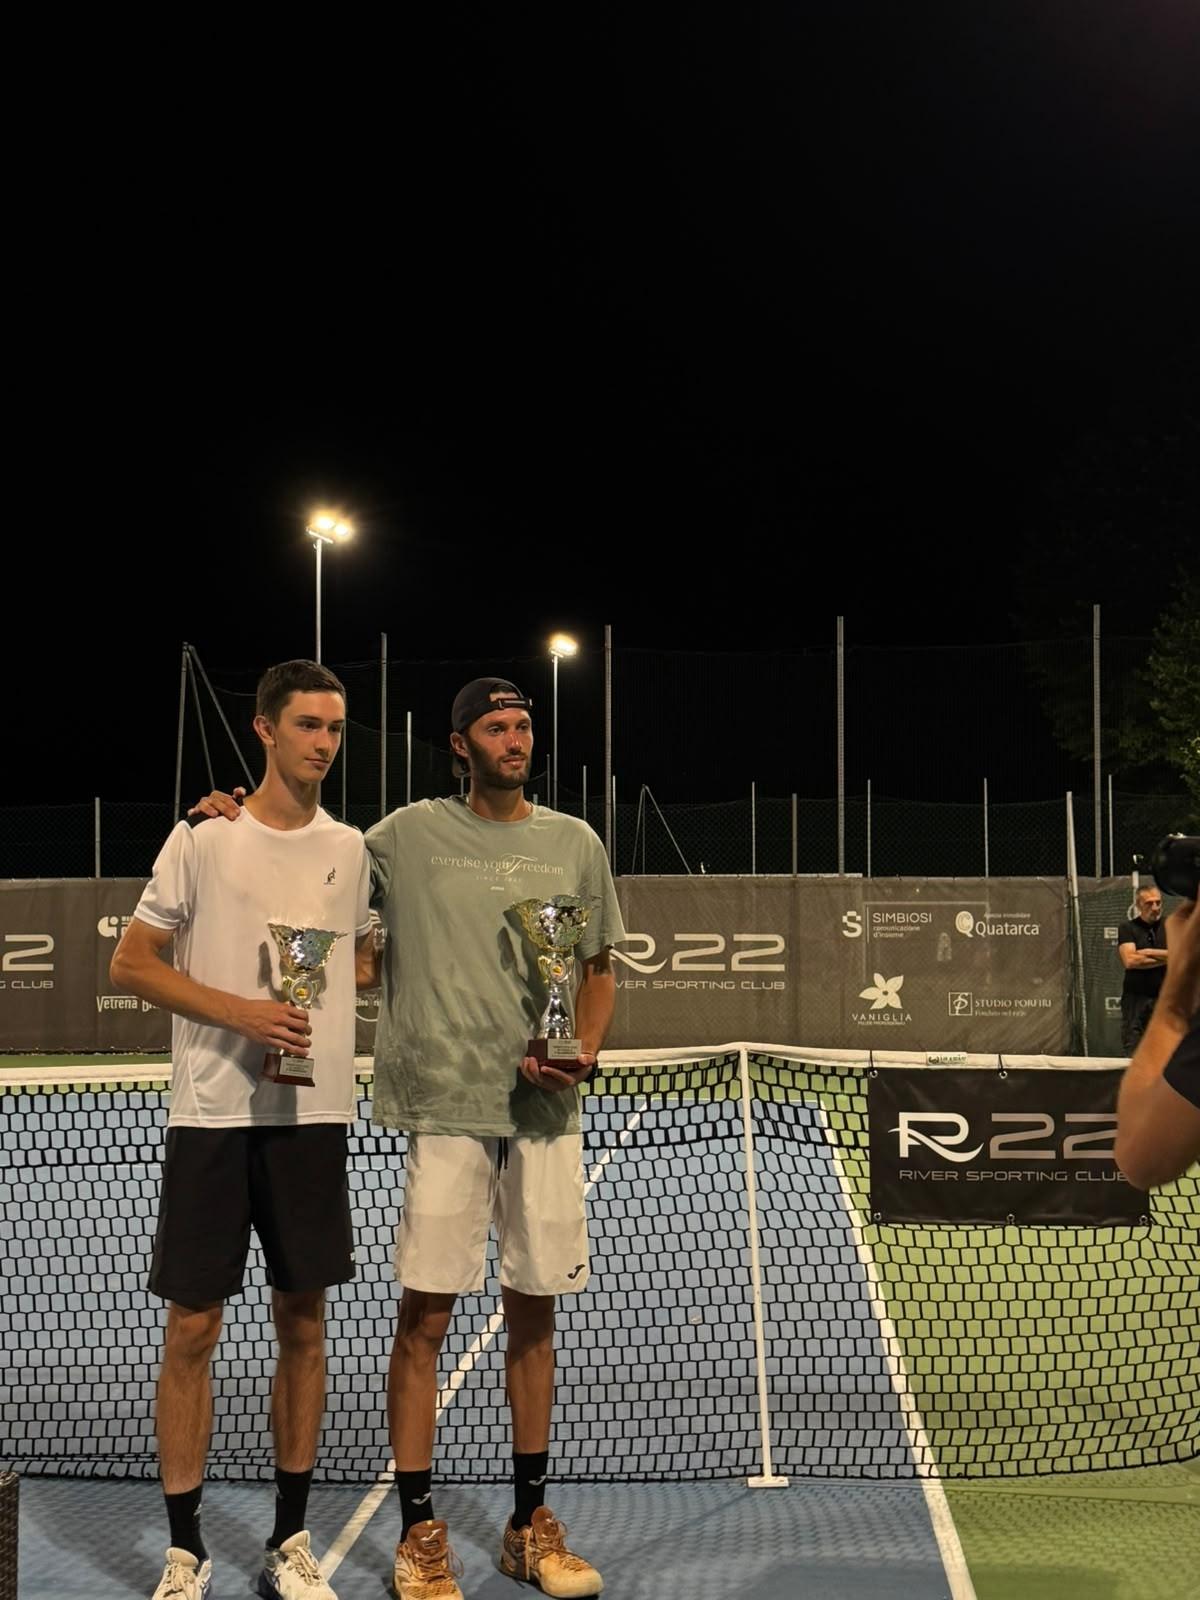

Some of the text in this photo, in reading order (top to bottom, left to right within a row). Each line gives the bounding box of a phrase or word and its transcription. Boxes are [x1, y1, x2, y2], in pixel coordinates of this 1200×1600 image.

[430, 855, 481, 869] exercise
[872, 912, 932, 924] SIMBIOSI
[975, 921, 1040, 938] Quatarca
[11, 980, 54, 989] CLUB
[615, 980, 785, 990] VER SPORTING CLUB
[851, 1013, 912, 1022] VANIGLIA
[900, 1169, 959, 1182] RIVER
[966, 1169, 1069, 1182] SPORTING
